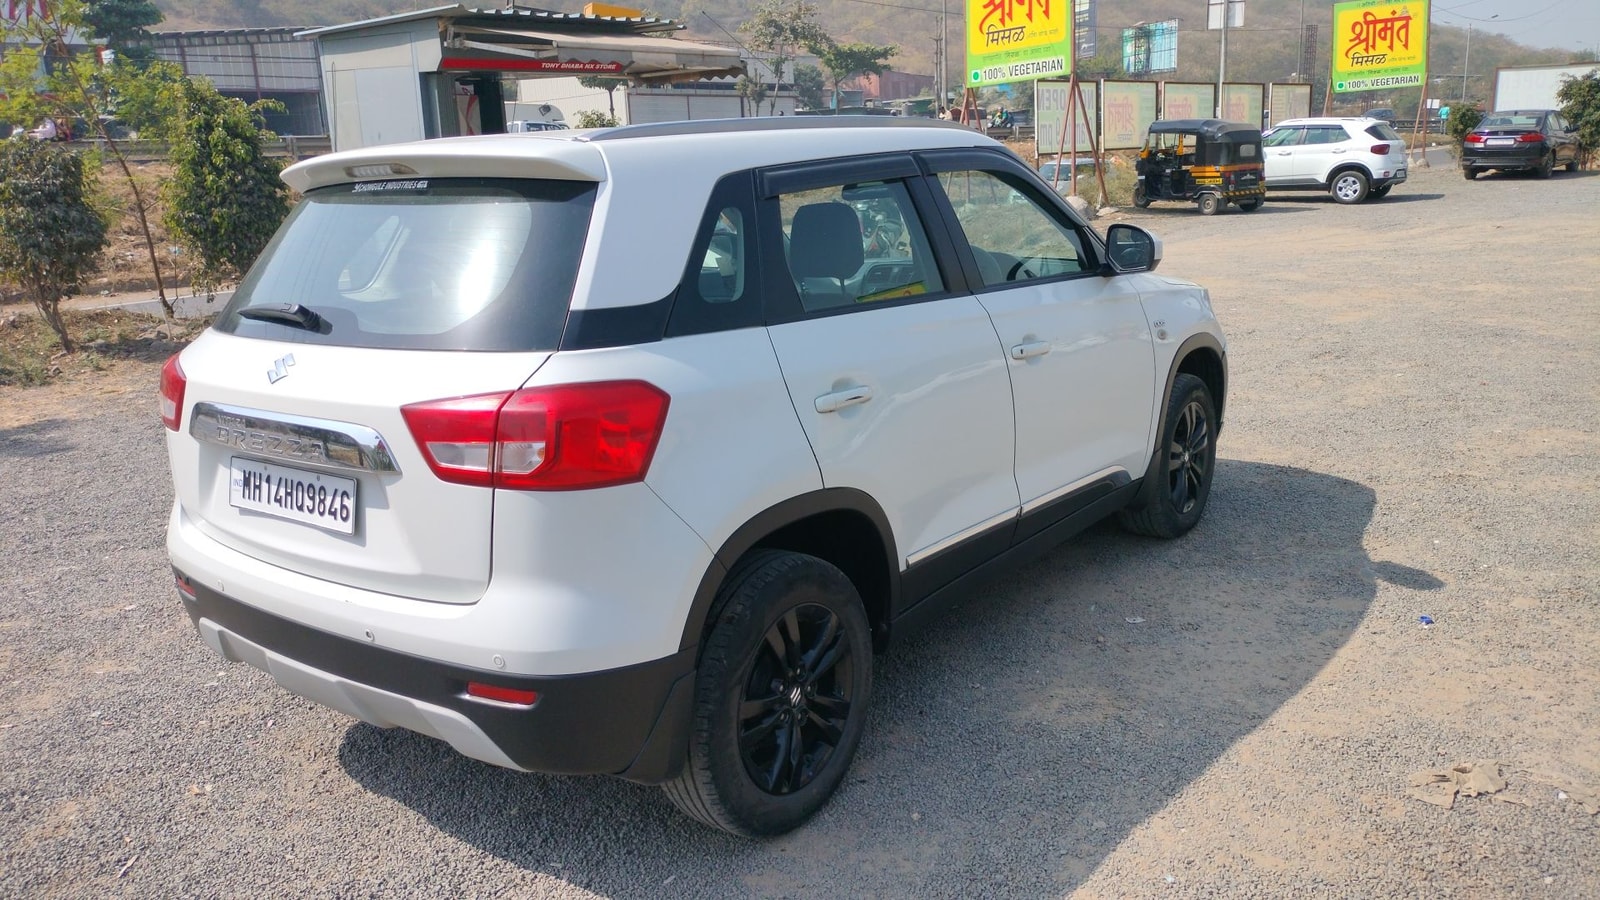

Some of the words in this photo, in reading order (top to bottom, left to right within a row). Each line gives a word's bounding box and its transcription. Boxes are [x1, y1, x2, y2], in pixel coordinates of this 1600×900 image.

[986, 24, 1026, 47] मिसळ
[1345, 9, 1413, 59] श्रीमंत
[983, 67, 1006, 80] 100%
[1008, 59, 1063, 77] VEGETARIAN
[1351, 52, 1387, 67] मिसळ
[1347, 80, 1368, 89] 100%
[1370, 75, 1419, 87] VEGETARIAN
[217, 425, 329, 463] BREZZA
[242, 469, 350, 523] MH14HQ9846
